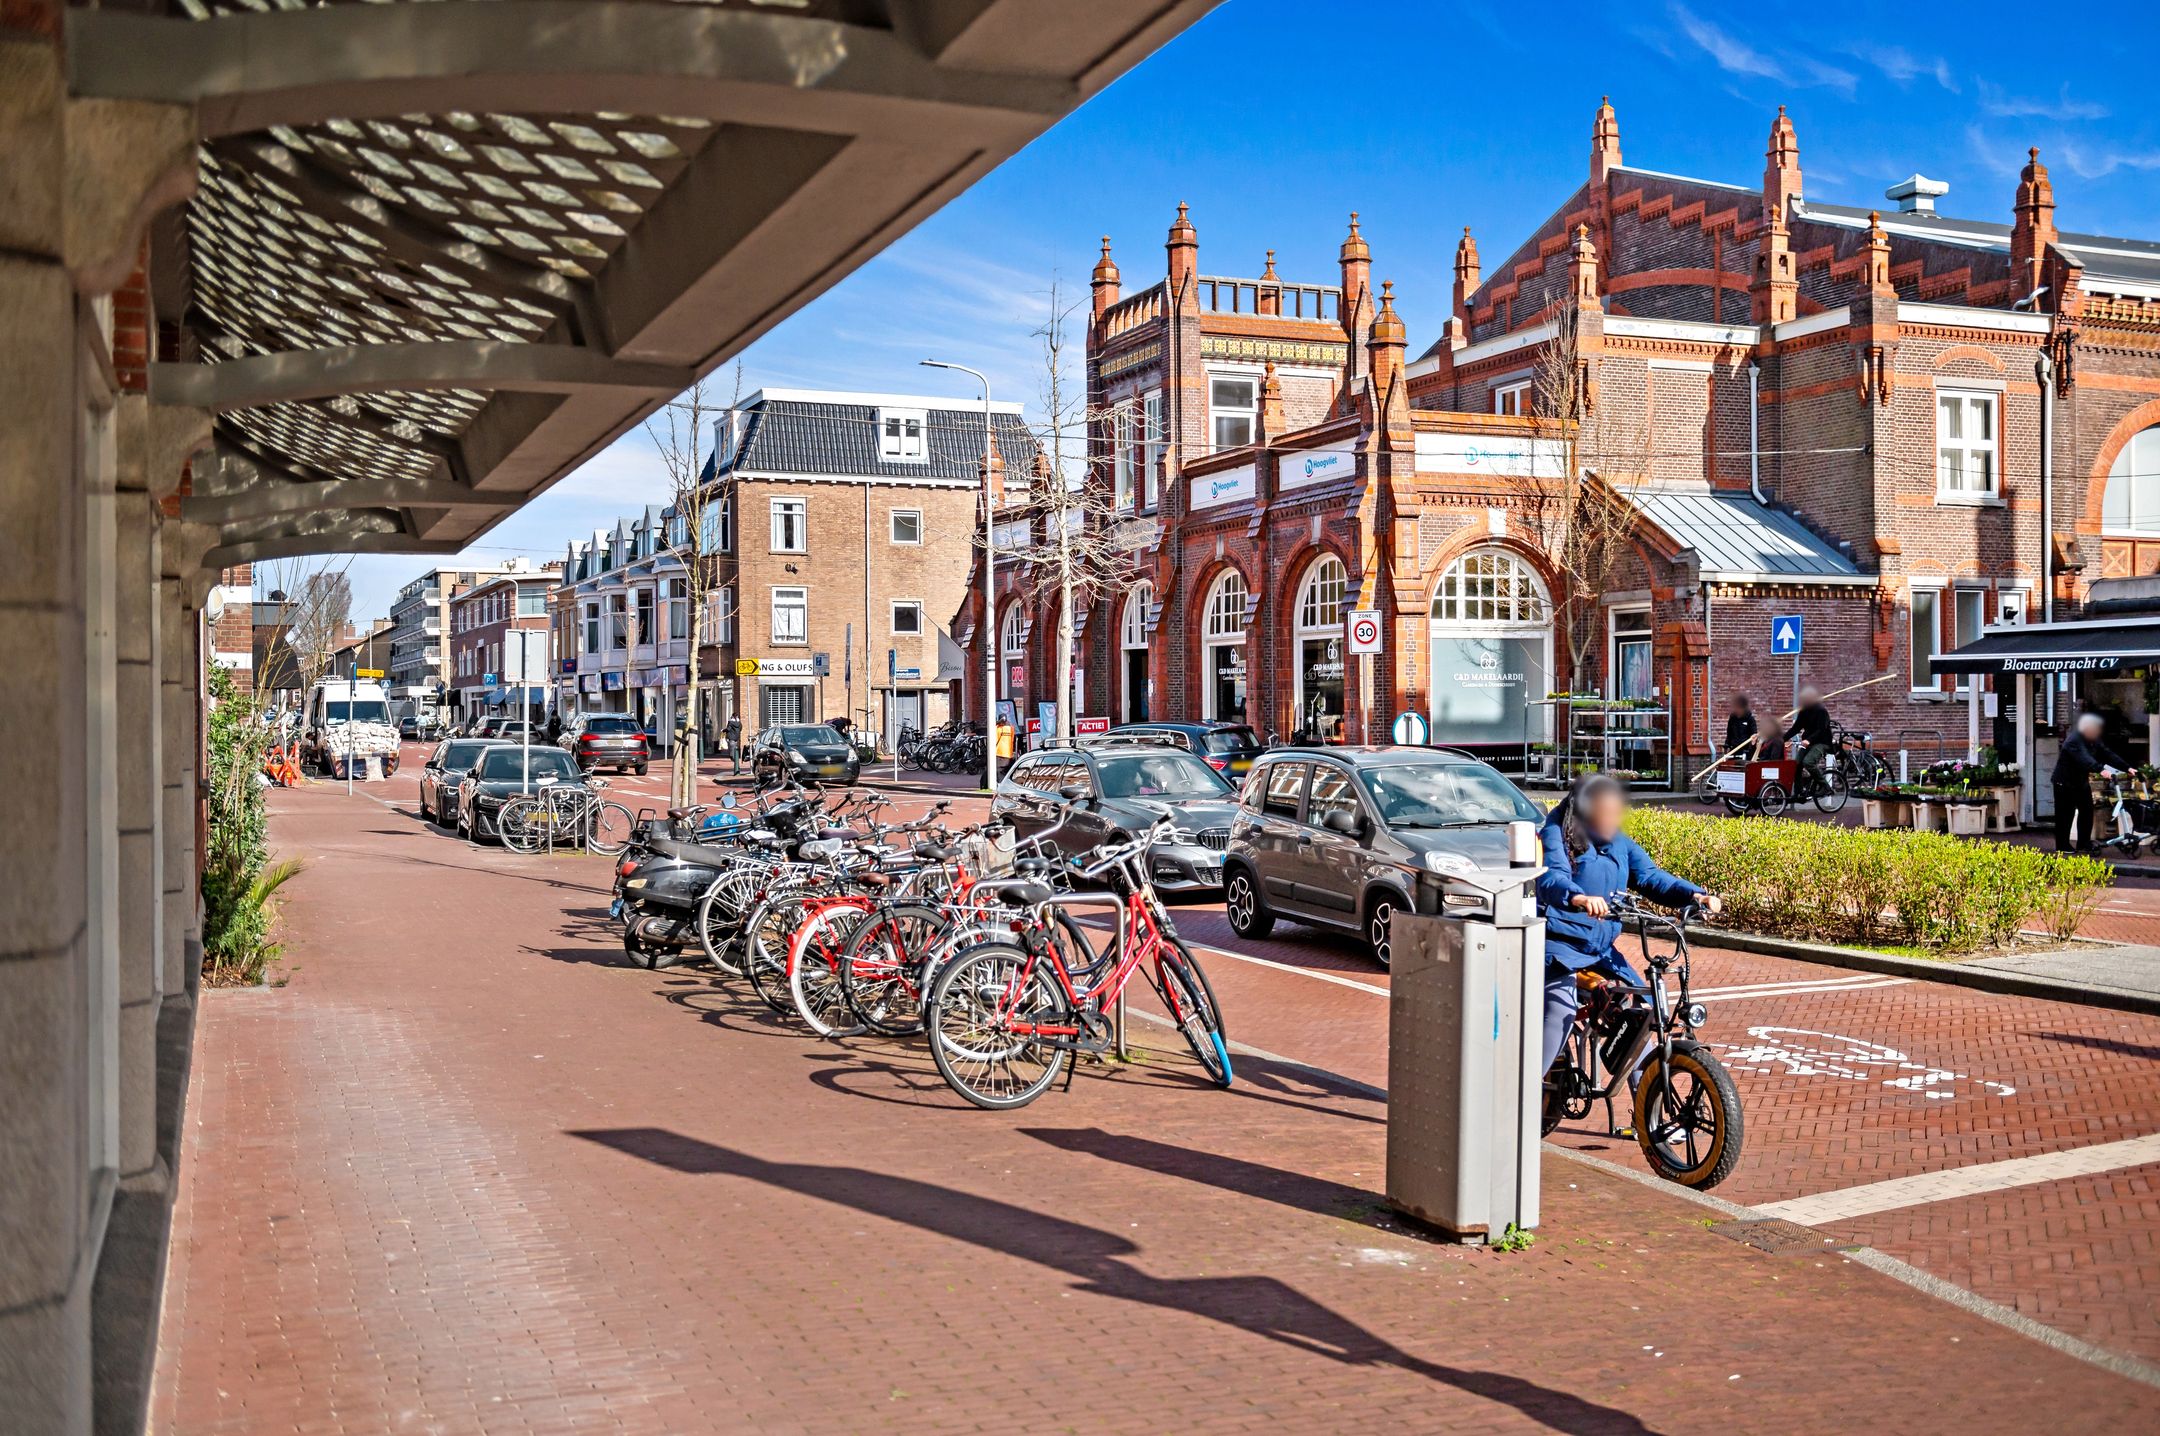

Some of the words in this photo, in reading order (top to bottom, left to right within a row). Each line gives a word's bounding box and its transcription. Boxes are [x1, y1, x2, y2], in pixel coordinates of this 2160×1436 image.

[1312, 455, 1338, 470] Hoogvliet
[1217, 479, 1239, 492] Hoogvliet
[1358, 628, 1373, 637] 30
[777, 663, 783, 671] &
[2002, 657, 2098, 673] Bloemenpracht
[2099, 657, 2119, 669] CV
[1471, 673, 1524, 682] MAKELAARDIJ
[1081, 722, 1105, 731] ACTIE!
